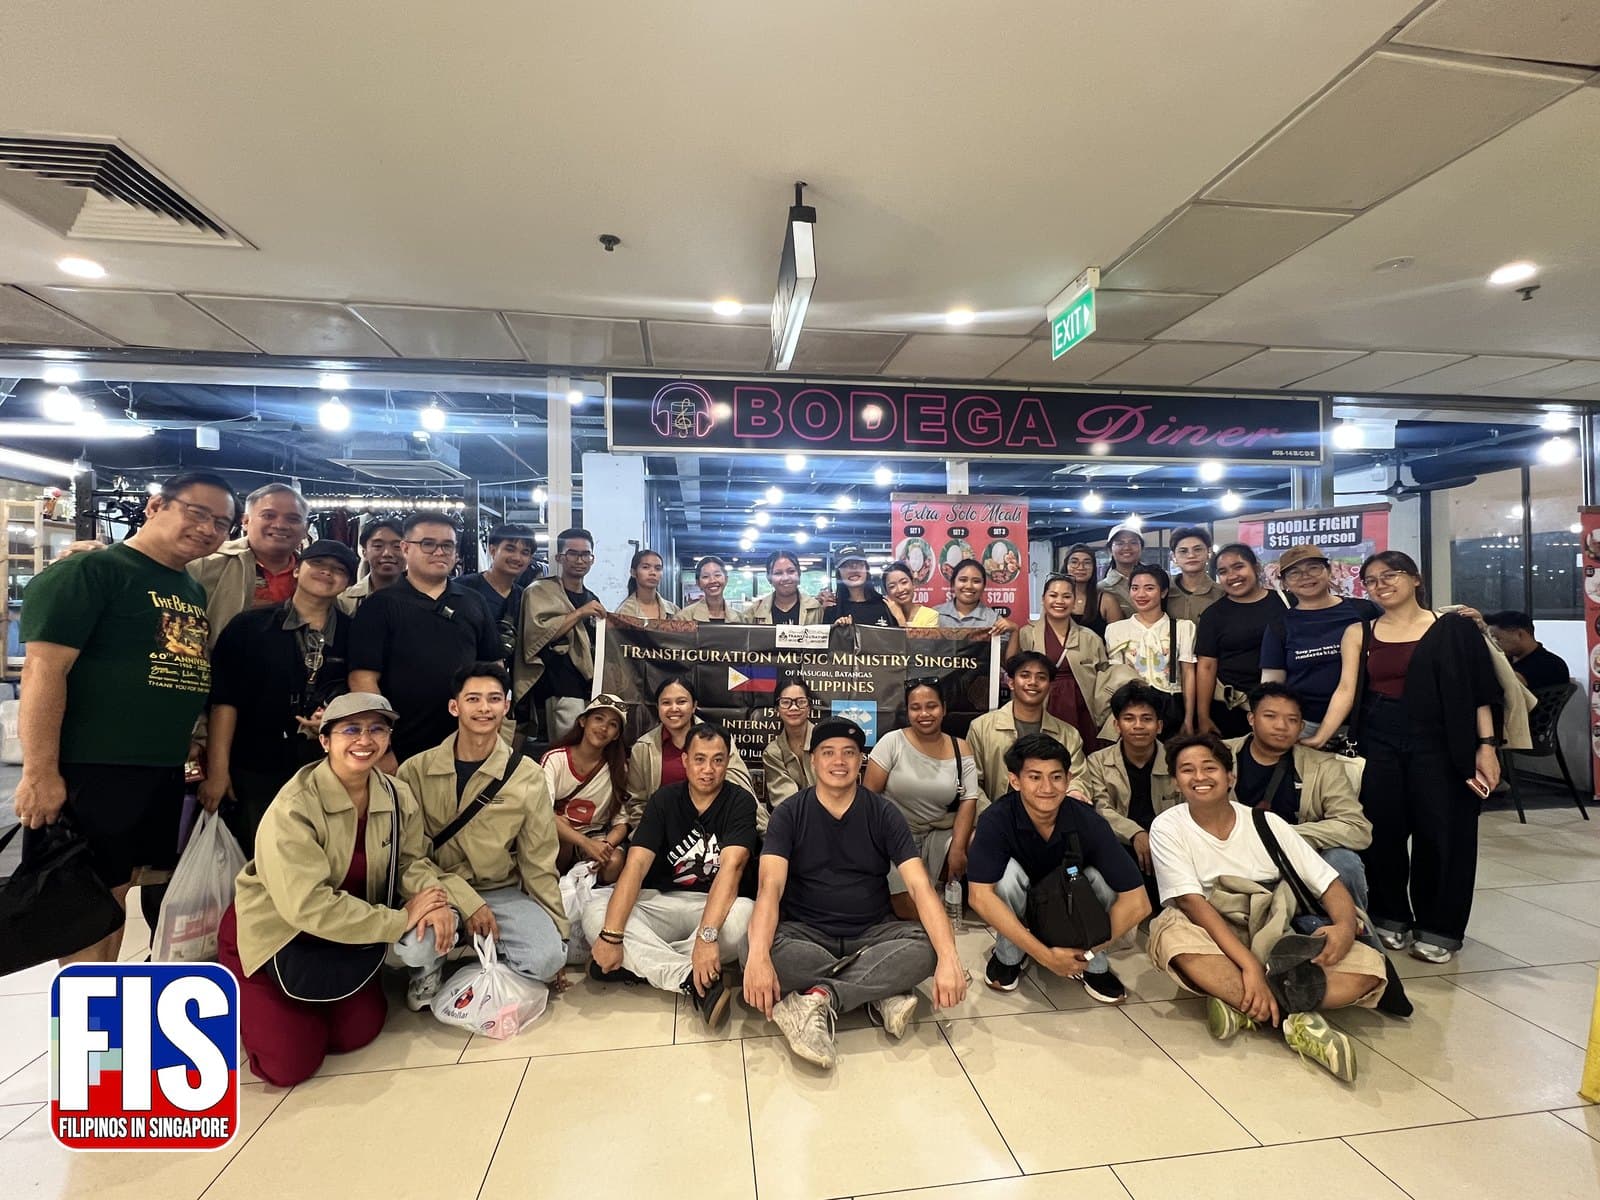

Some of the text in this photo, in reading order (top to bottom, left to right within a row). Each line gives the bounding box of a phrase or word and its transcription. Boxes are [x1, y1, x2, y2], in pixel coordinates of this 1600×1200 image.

[1055, 305, 1082, 351] EXIT
[733, 386, 1288, 447] BODEGA Diner
[901, 503, 1022, 523] Extra Solo Meals
[1267, 515, 1360, 535] BOODLE FIGHT
[1269, 532, 1356, 547] $15 per person
[171, 594, 206, 618] BEATL
[912, 592, 929, 603] 2.00
[987, 592, 1015, 603] $12.00
[620, 644, 977, 670] TRANSFIGURATION MUSIC MINISTRY SINGERS
[806, 681, 875, 693] LIPPINES
[722, 718, 781, 730] INTERNAT
[733, 734, 764, 744] HOIR
